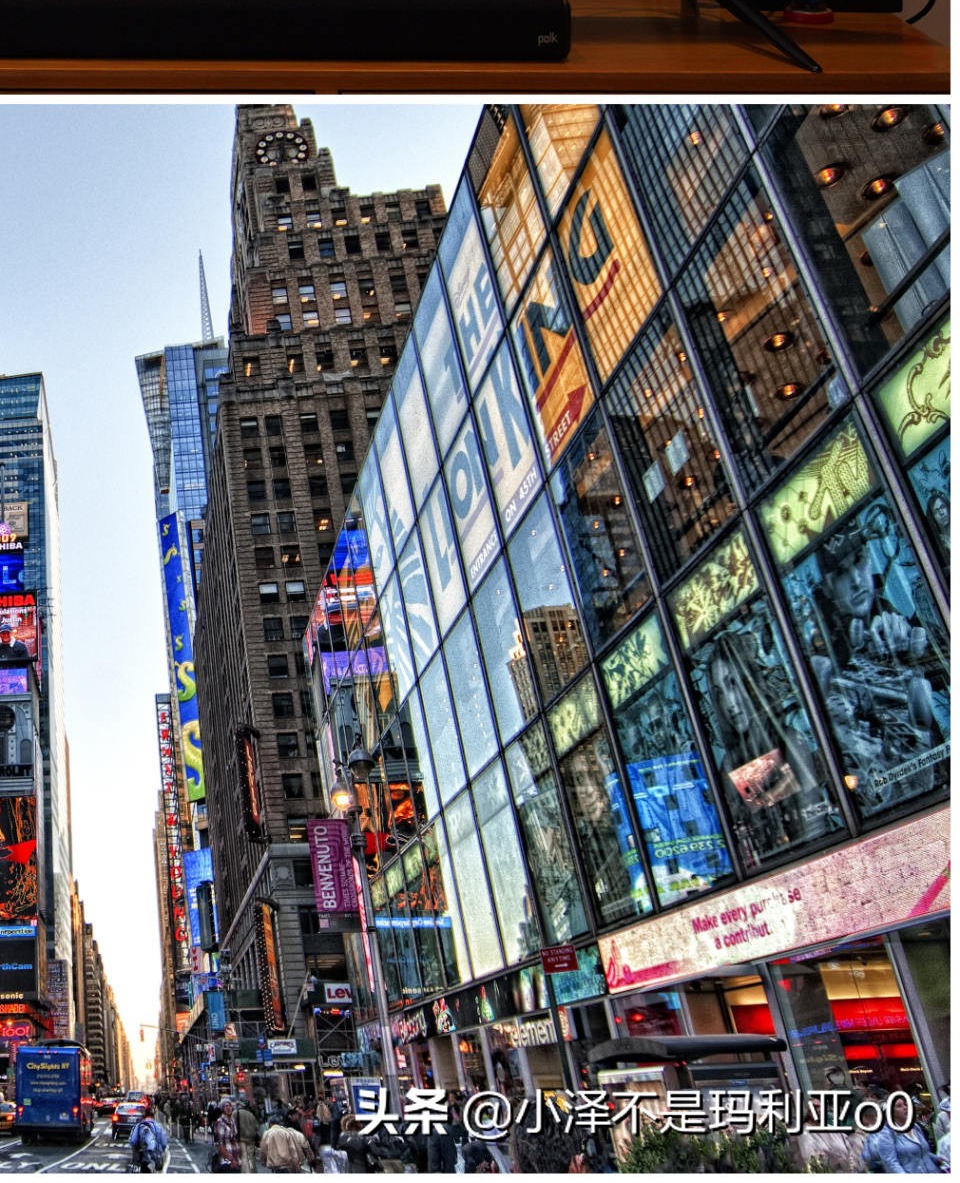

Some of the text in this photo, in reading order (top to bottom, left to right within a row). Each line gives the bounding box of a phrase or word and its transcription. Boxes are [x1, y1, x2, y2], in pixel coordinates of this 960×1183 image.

[537, 31, 558, 47] polk
[470, 410, 573, 579] ENTRANCE ON 45TH STREET
[314, 825, 337, 909] BENVENUTO
[692, 905, 748, 934] Make every
[714, 937, 723, 950] a
